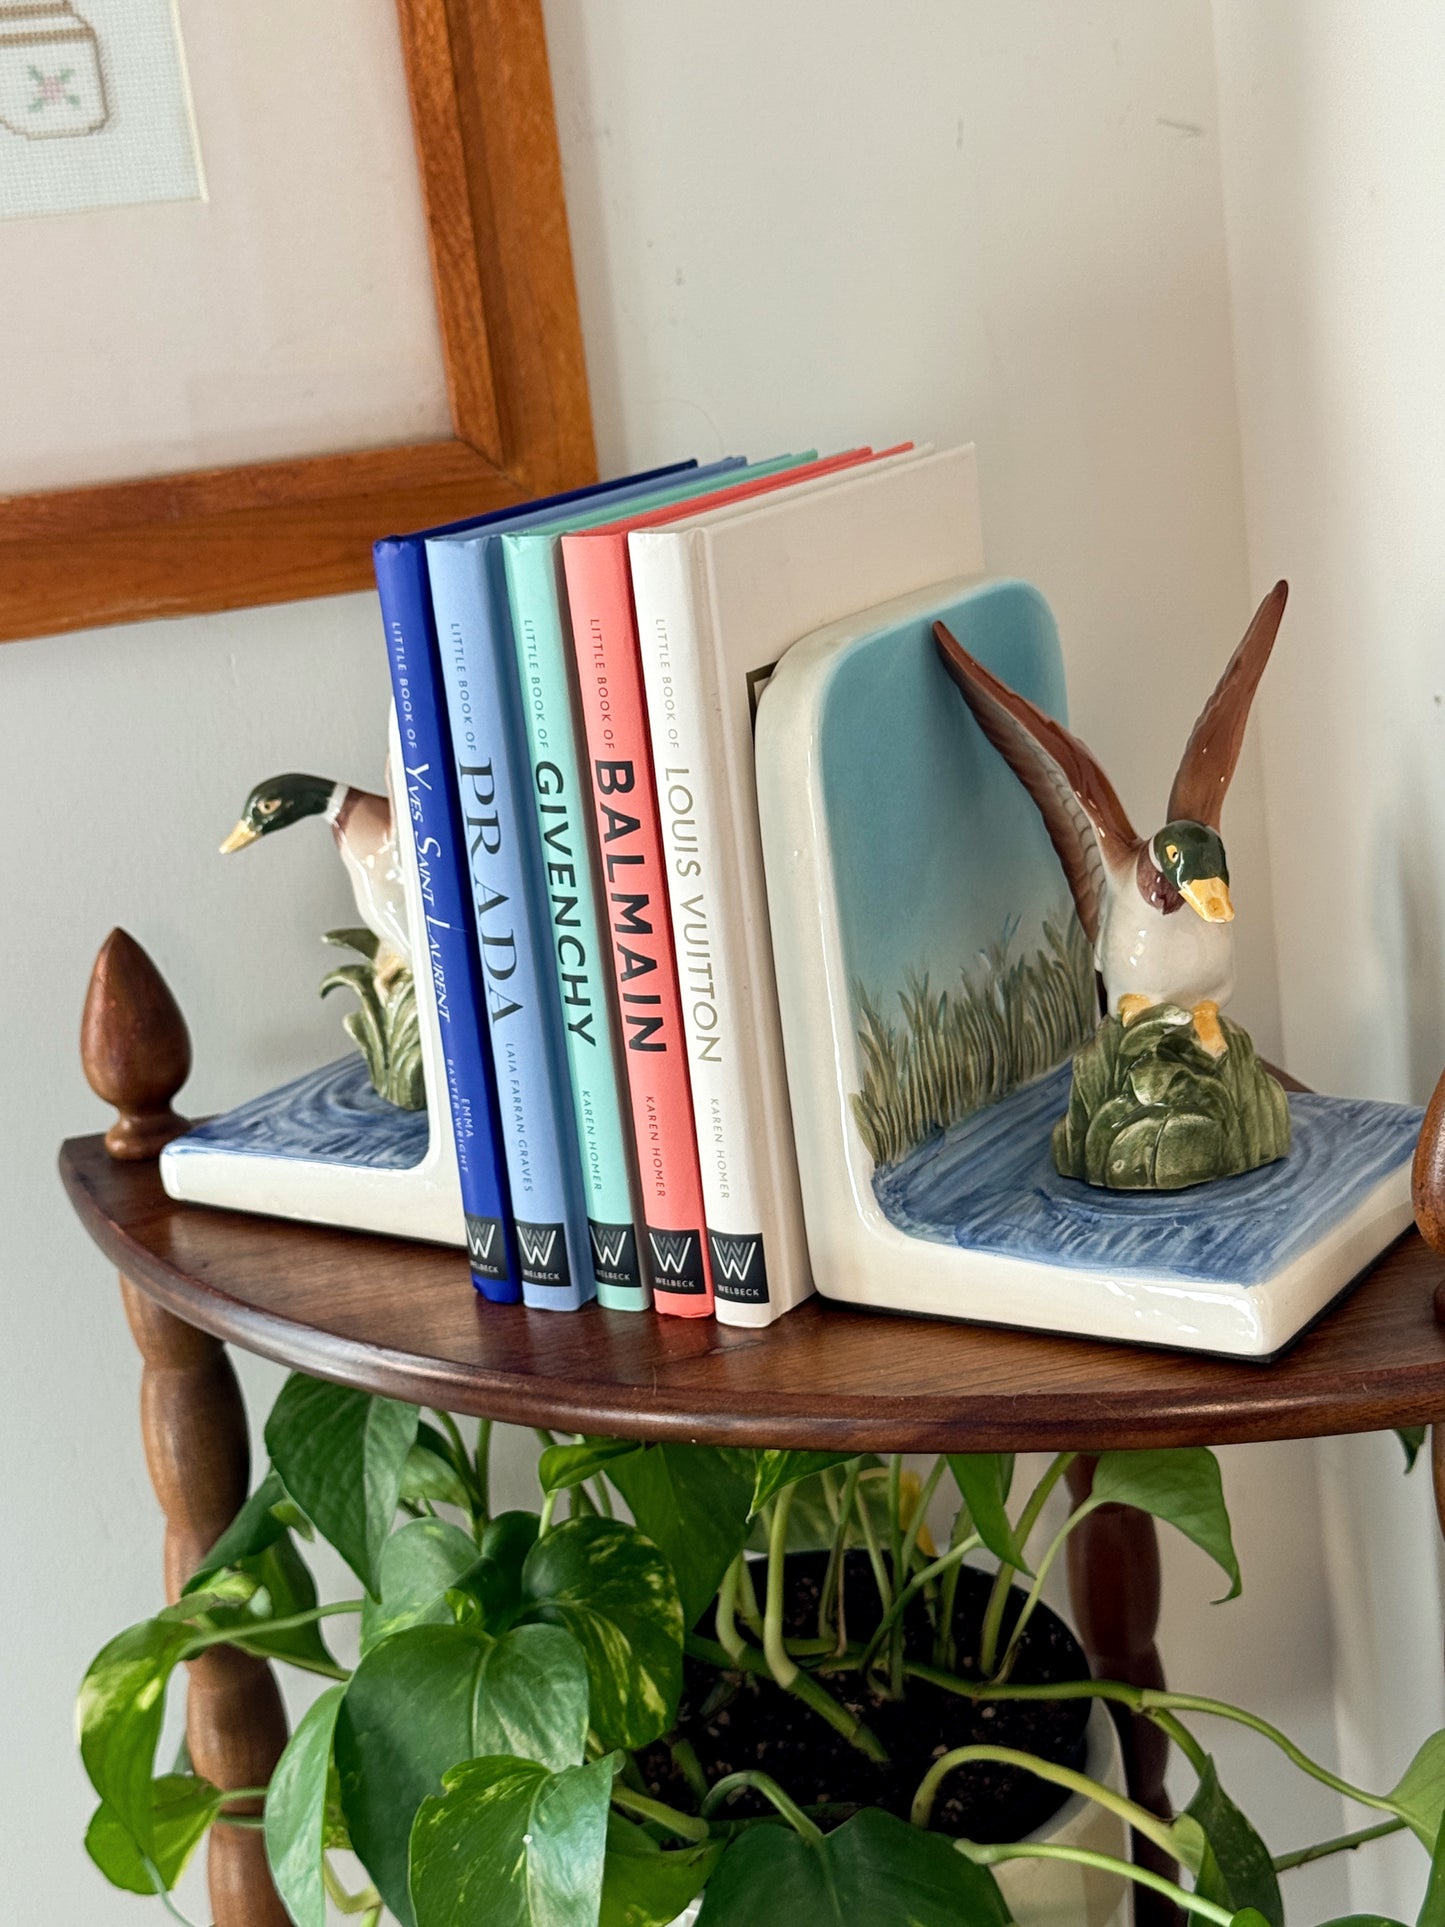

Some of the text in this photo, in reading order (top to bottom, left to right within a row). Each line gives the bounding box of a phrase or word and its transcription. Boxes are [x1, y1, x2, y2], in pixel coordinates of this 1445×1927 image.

[391, 621, 417, 749] LITTLE BOOK OF
[450, 622, 477, 751] LITTLE BOOK OF
[524, 619, 549, 748] LITTLE BOOK OF
[590, 618, 615, 749] LITTLE BOOK OF
[655, 618, 679, 749] LITTLE BOOK OF
[458, 757, 523, 1025] PRADA
[535, 761, 596, 1047] GIVENCHY
[595, 759, 667, 1052] BALMAIN
[665, 767, 722, 1063] LOUIS VUITTON
[461, 1097, 474, 1138] EMMA
[505, 1042, 533, 1192] LAIA FARRAN GRAVES
[582, 1089, 602, 1190] KAREN HOMER
[645, 1095, 666, 1197] KAREN HOMER
[710, 1097, 730, 1199] KAREN HOMER
[516, 1225, 557, 1267] W
[523, 1268, 561, 1281] WELBECK
[589, 1224, 627, 1267] W
[596, 1268, 632, 1281] WELBECK
[649, 1232, 692, 1274] W
[654, 1276, 695, 1288] WELBECK
[712, 1236, 757, 1281] W
[717, 1283, 760, 1297] WELBECK
